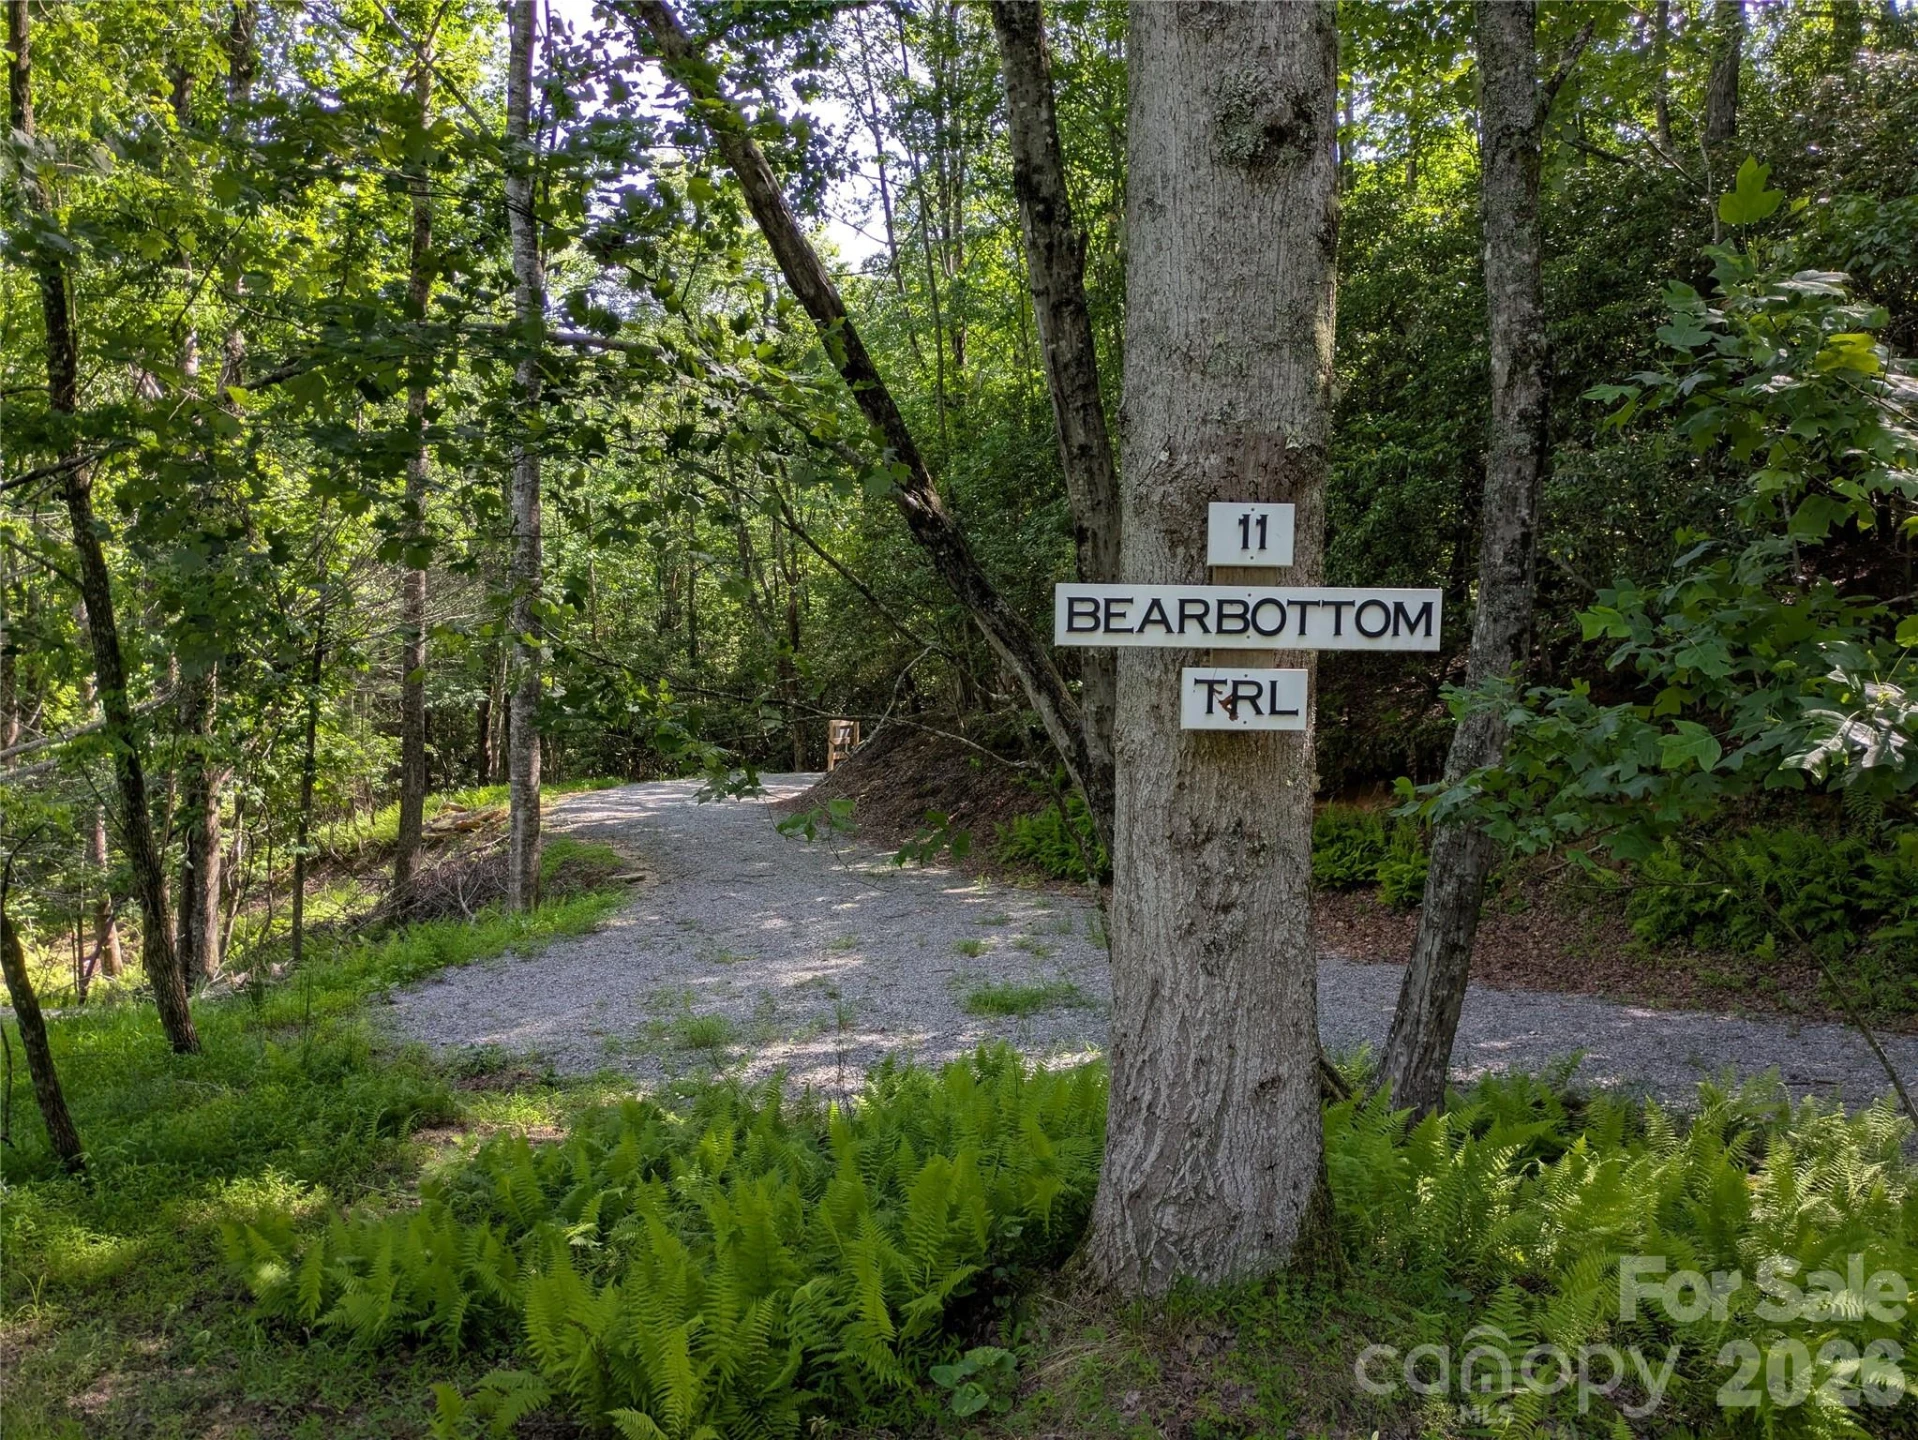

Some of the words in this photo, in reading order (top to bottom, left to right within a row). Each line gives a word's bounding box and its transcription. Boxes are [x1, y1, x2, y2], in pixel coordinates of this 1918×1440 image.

[1238, 514, 1268, 550] 11
[1066, 597, 1433, 637] BEARBOTTOM
[1194, 678, 1298, 716] TRL
